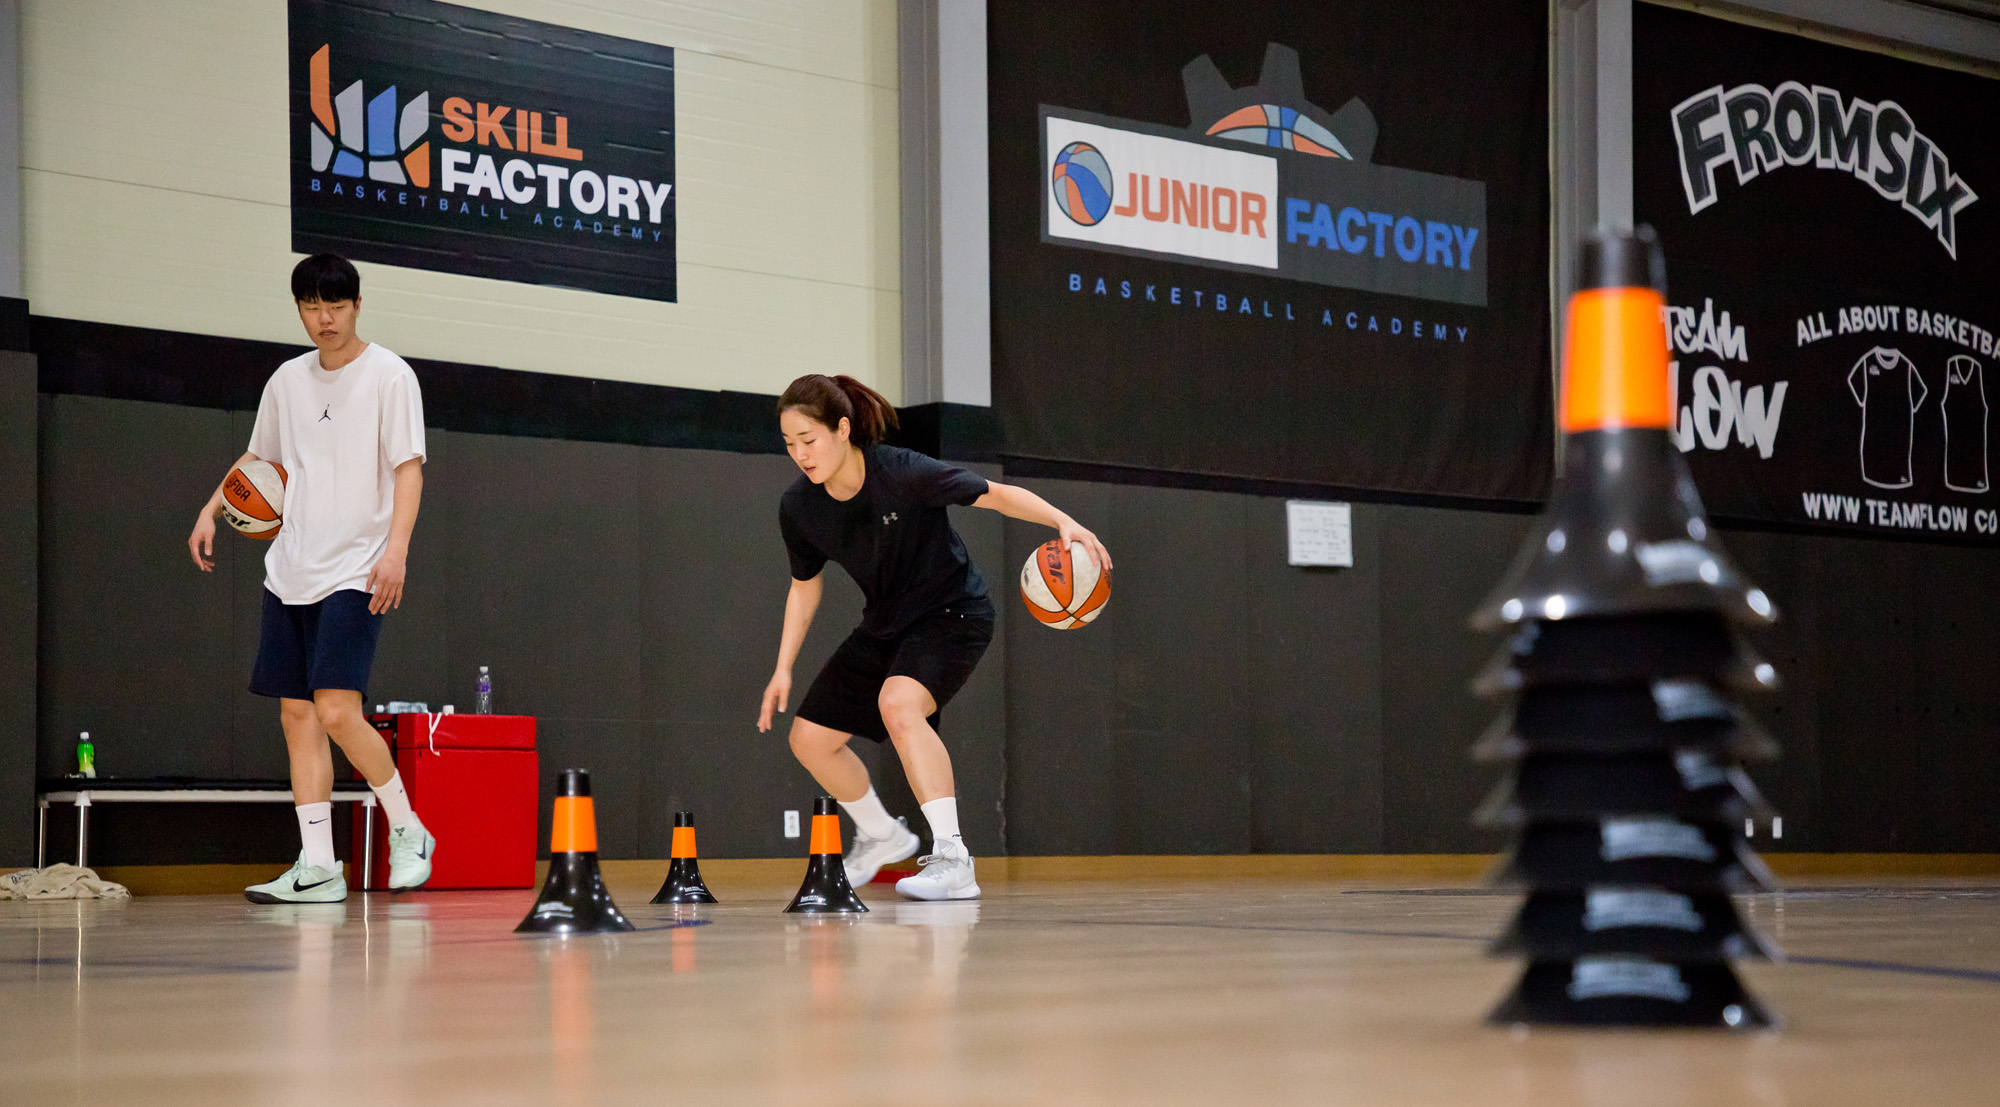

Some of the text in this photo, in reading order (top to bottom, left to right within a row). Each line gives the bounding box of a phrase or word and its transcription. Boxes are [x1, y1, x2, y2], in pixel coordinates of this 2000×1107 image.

[441, 96, 583, 161] SKILL
[441, 147, 672, 224] FACTORY
[1670, 80, 1979, 261] FROMSIX
[311, 178, 661, 242] BASKETBALL ACADEMY
[1114, 172, 1479, 270] JUNIOR FACTORY
[1069, 273, 1468, 343] BASKETBALL ACADEMY
[1796, 311, 1833, 347] ALL
[1838, 305, 1900, 335] ABOUT
[1667, 360, 1789, 460] LOW
[231, 479, 252, 502] FIBA
